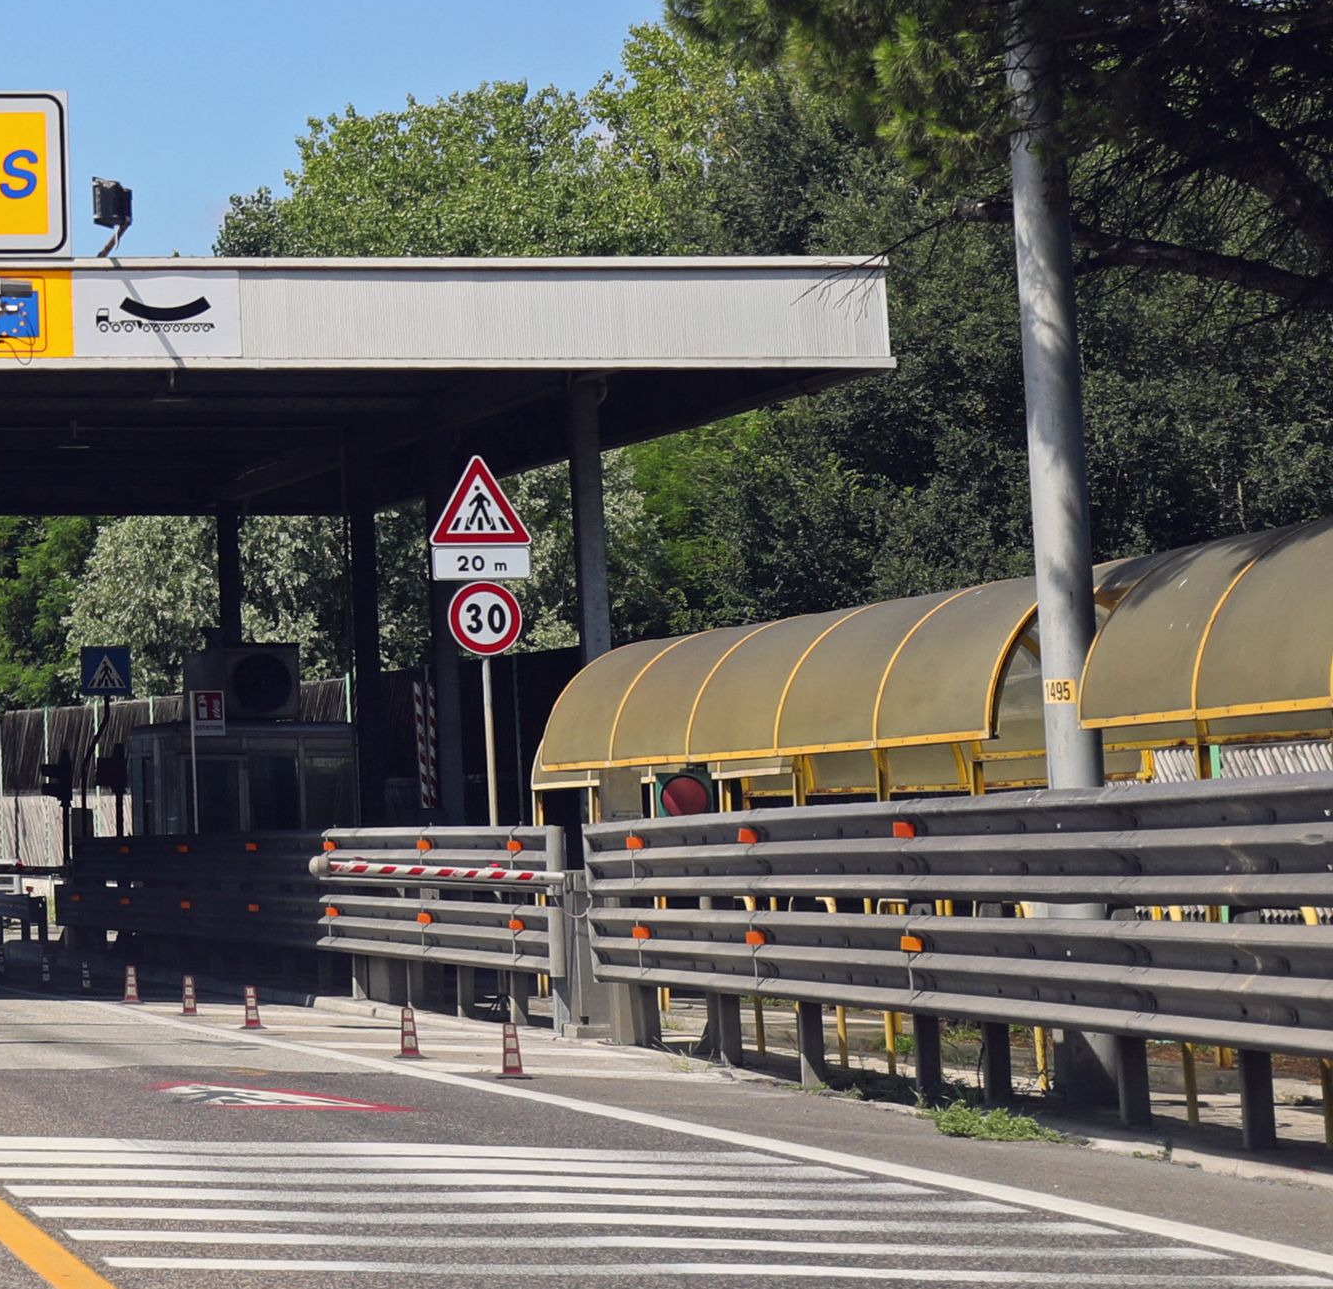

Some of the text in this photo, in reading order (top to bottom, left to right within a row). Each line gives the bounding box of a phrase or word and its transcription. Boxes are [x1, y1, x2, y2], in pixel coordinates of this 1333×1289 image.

[457, 555, 508, 572] 20 m
[465, 602, 507, 636] 30
[1045, 681, 1071, 701] 1495
